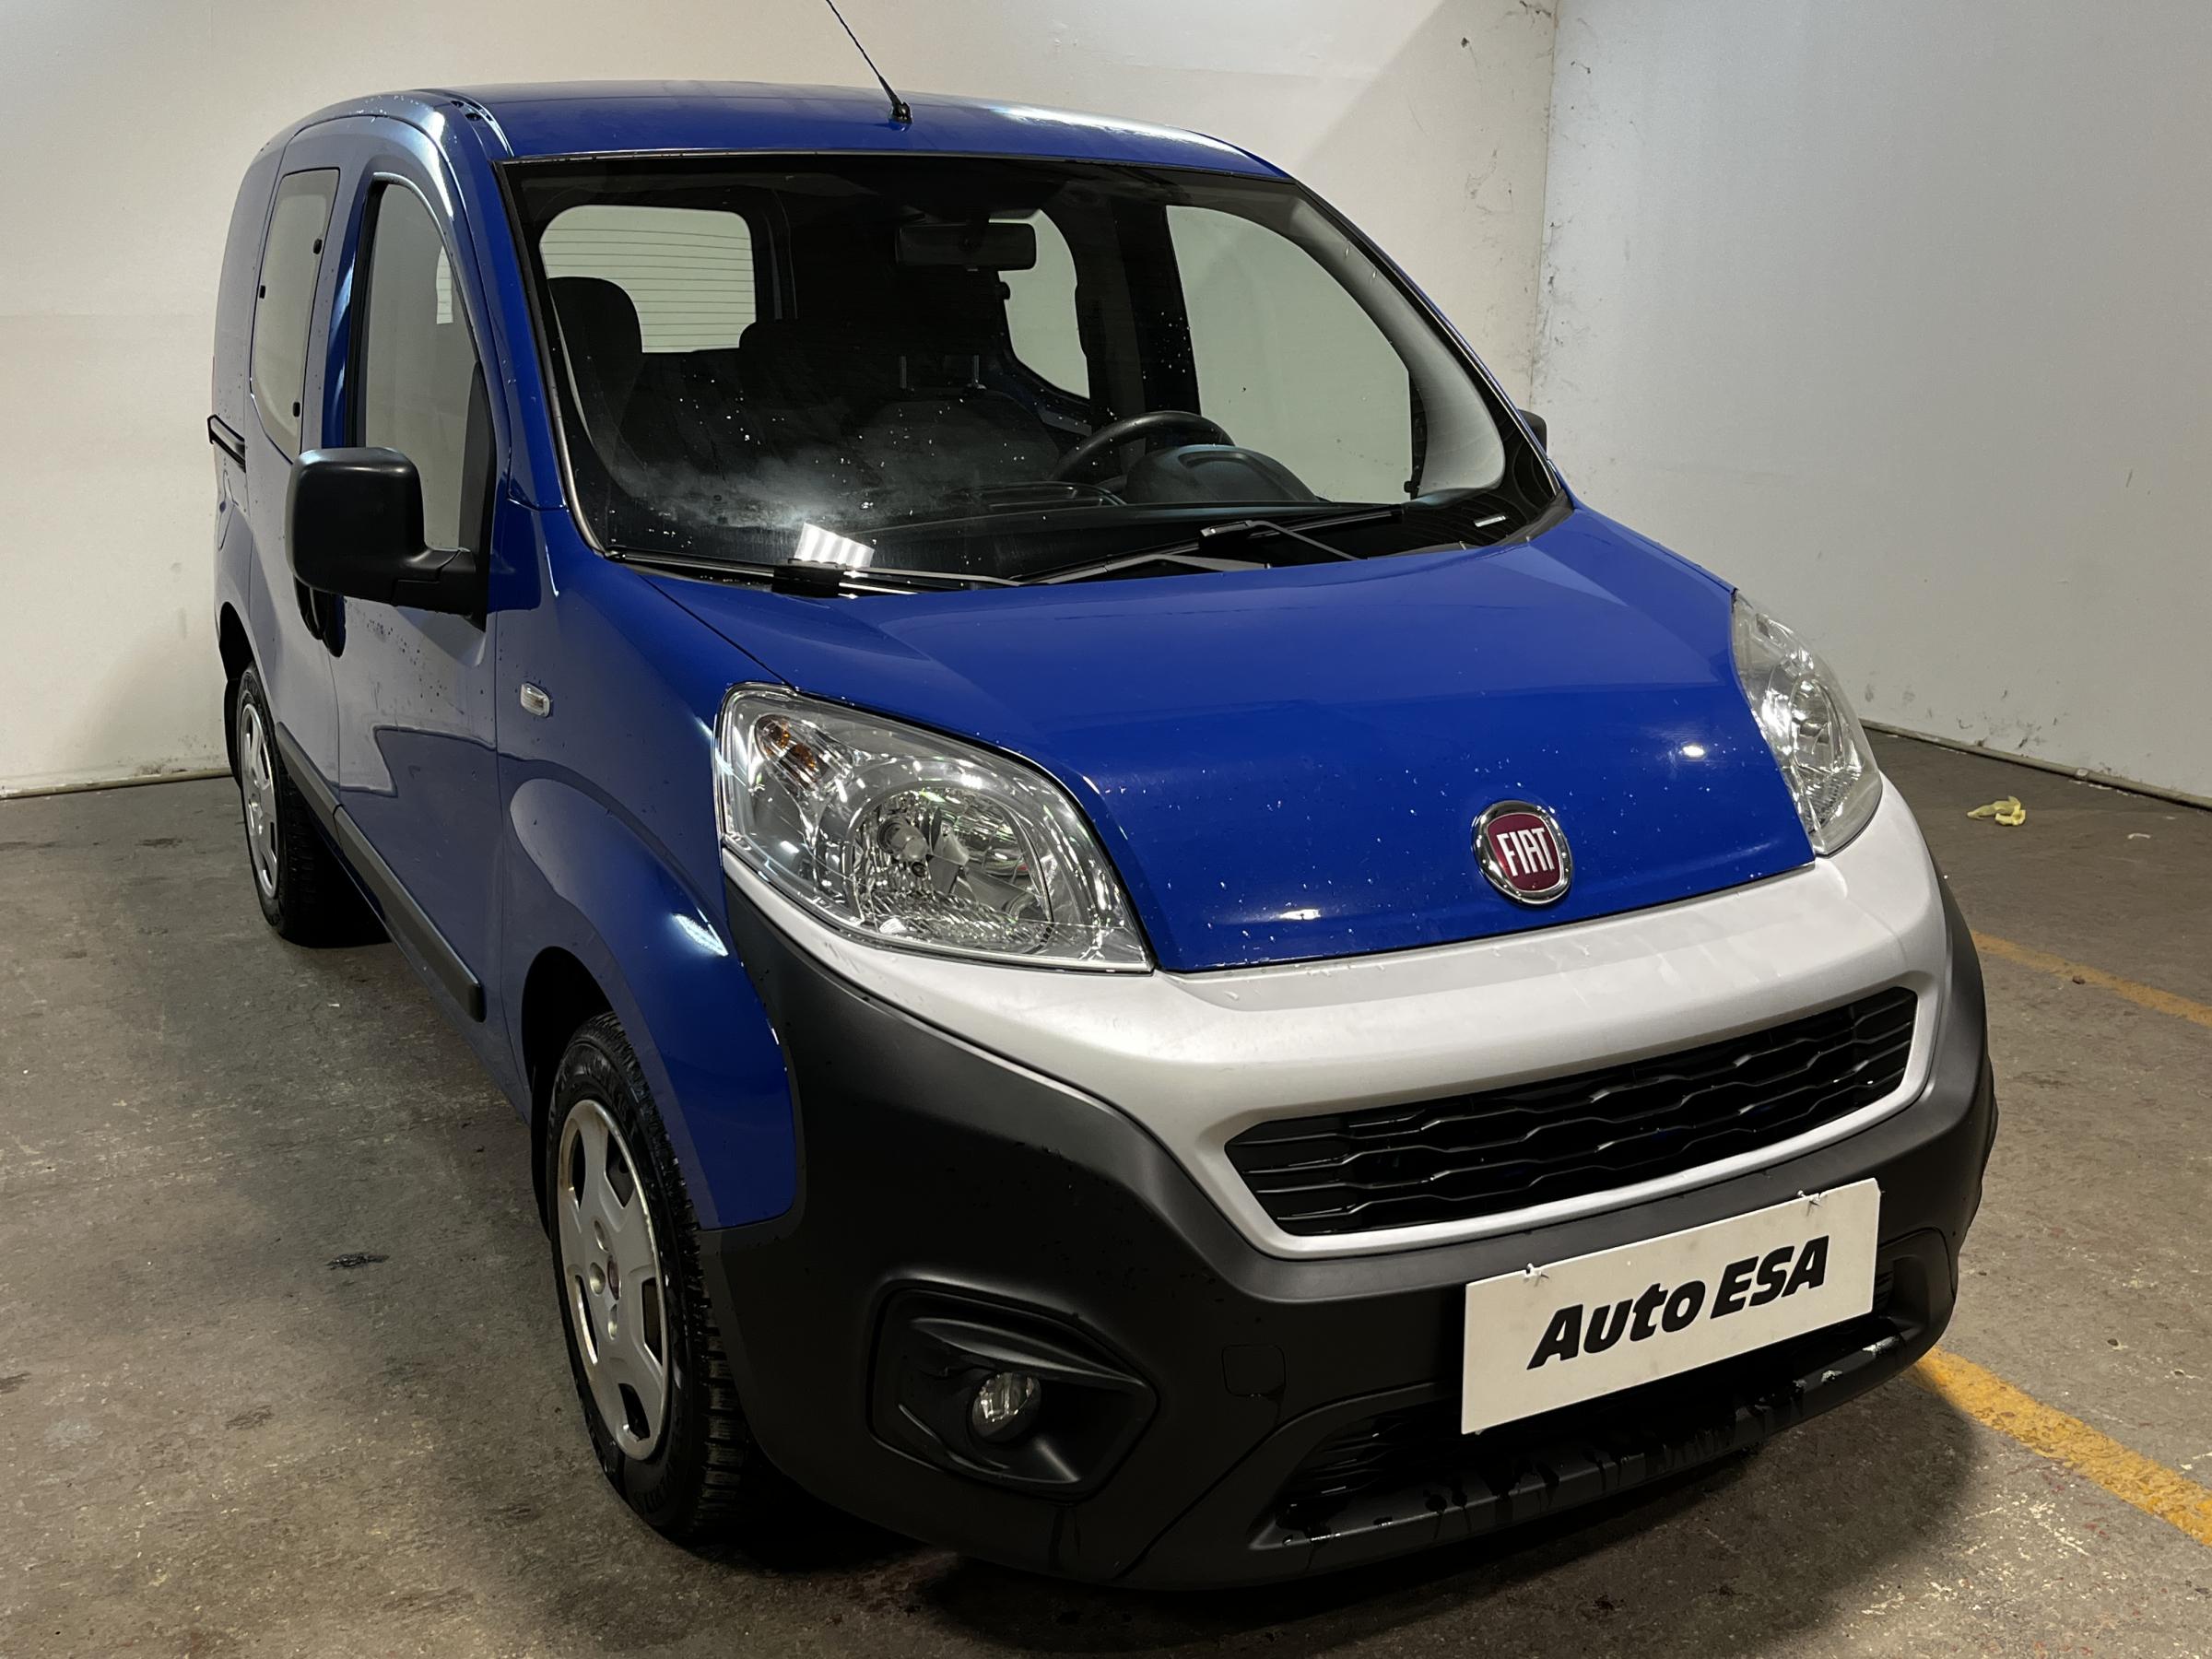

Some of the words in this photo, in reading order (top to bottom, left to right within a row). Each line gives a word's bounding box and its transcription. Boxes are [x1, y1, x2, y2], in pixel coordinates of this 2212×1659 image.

[1496, 828, 1555, 877] FIAT
[1526, 1280, 1706, 1371] Auto
[1710, 1235, 1830, 1320] ESA
